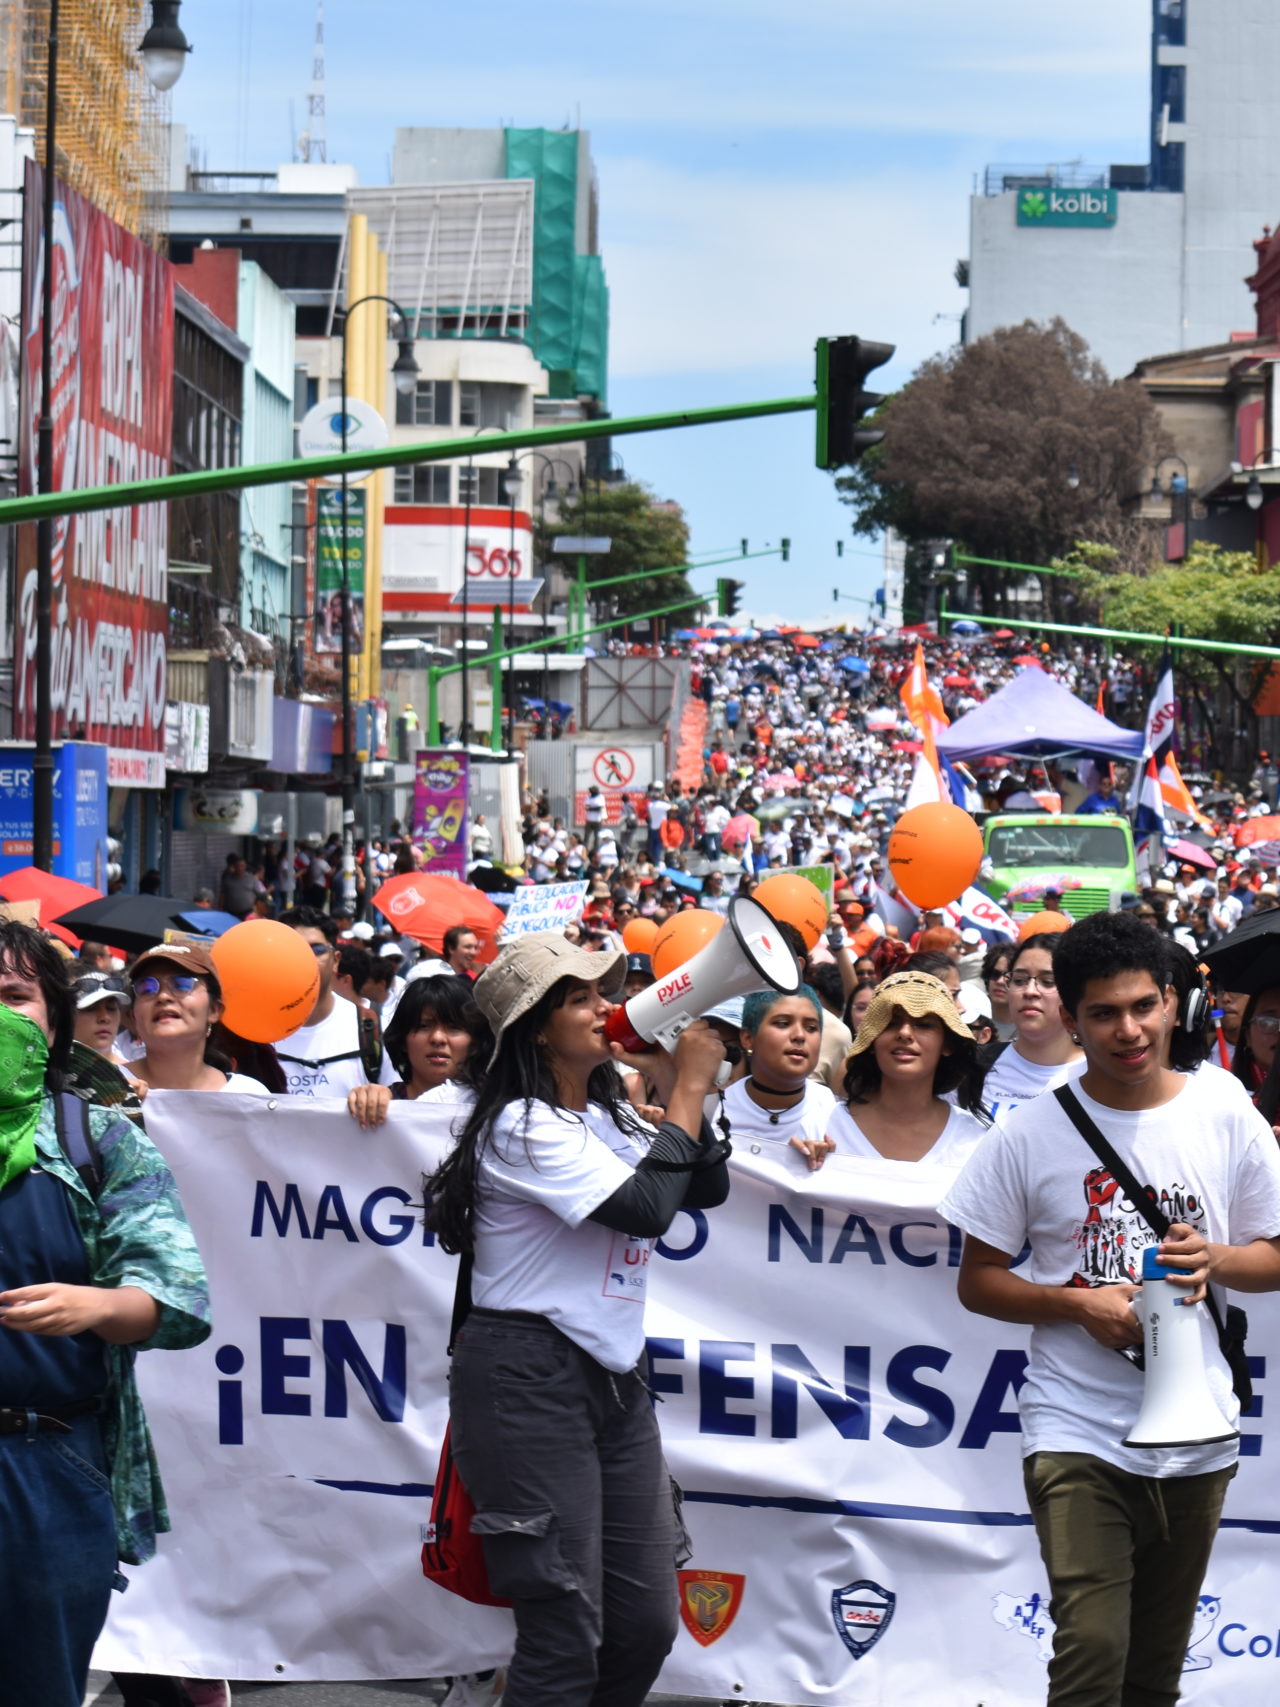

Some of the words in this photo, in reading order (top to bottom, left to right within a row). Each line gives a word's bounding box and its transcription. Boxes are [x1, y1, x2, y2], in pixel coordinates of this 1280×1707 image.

[101, 250, 143, 428] ROPA
[66, 615, 166, 732] AMERICANO
[554, 895, 577, 910] NO
[657, 973, 692, 1002] PYLE
[1151, 1325, 1159, 1357] Steren
